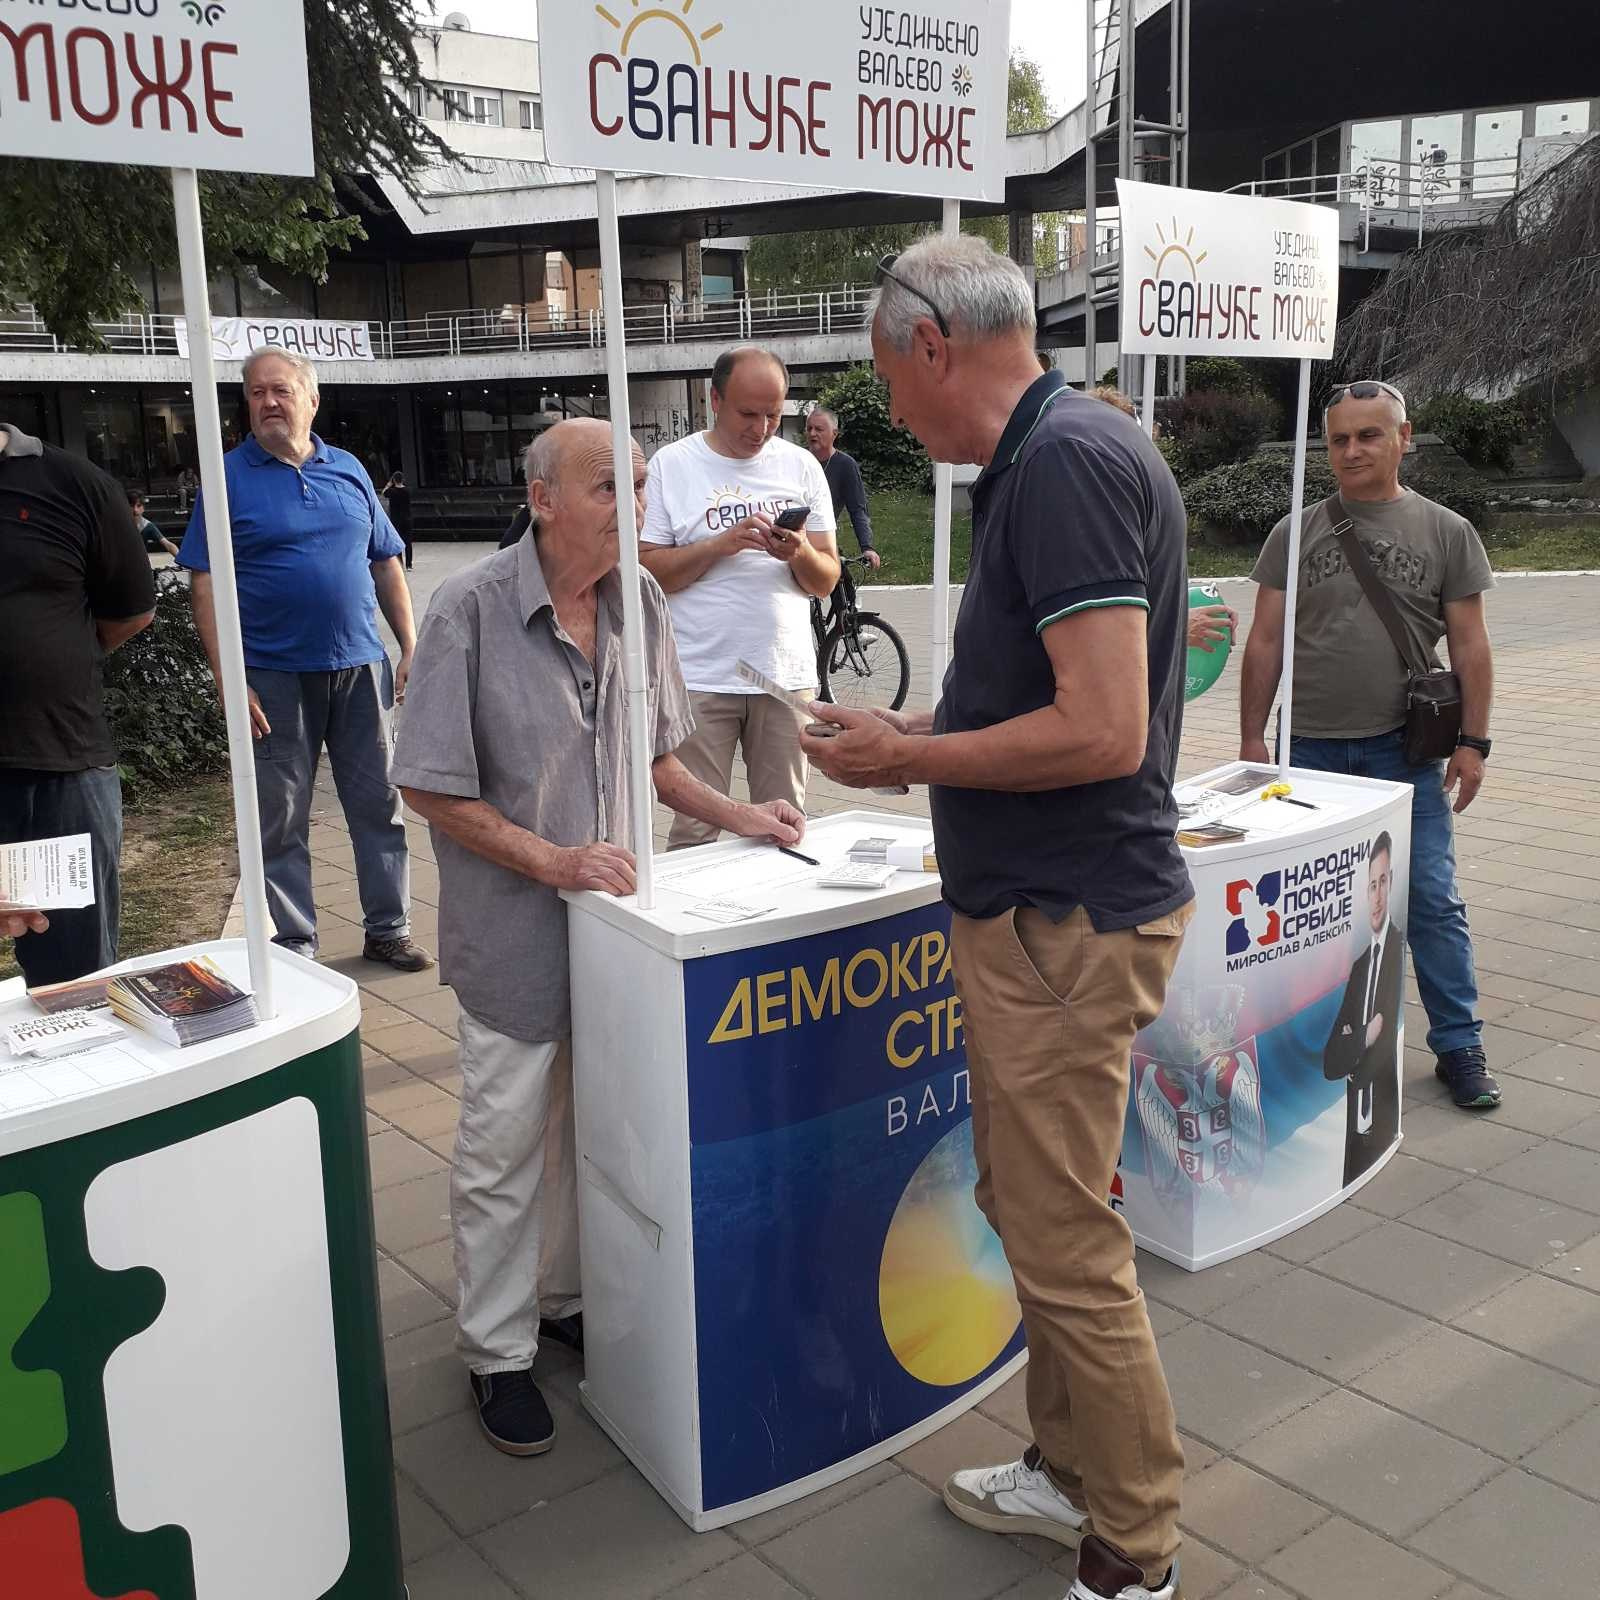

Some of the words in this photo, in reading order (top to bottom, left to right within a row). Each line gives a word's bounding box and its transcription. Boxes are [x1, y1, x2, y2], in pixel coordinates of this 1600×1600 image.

[859, 5, 979, 57] УЈЕДИЊЕНО
[0, 20, 244, 138] МОЖЕ
[858, 49, 942, 93] ВАЉЕВО
[588, 53, 832, 158] СВАНУЋЕ
[857, 93, 976, 172] МОЖЕ
[1273, 261, 1316, 289] ВАЉЕВО
[1138, 278, 1263, 341] СВАНУЋЕ
[1272, 292, 1329, 344] МОЖЕ
[246, 325, 367, 357] СВАНУЋЕ
[1284, 838, 1371, 889] НАРОДНИ
[1282, 895, 1353, 939] СРБИЈЕ
[1283, 869, 1356, 915] ПОКРЕТ
[1226, 940, 1300, 973] МИРОСЛАВ
[1303, 920, 1352, 950] АЛЕКСИЋ
[17, 1018, 98, 1042] МОЖЕ
[886, 995, 966, 1069] СТР
